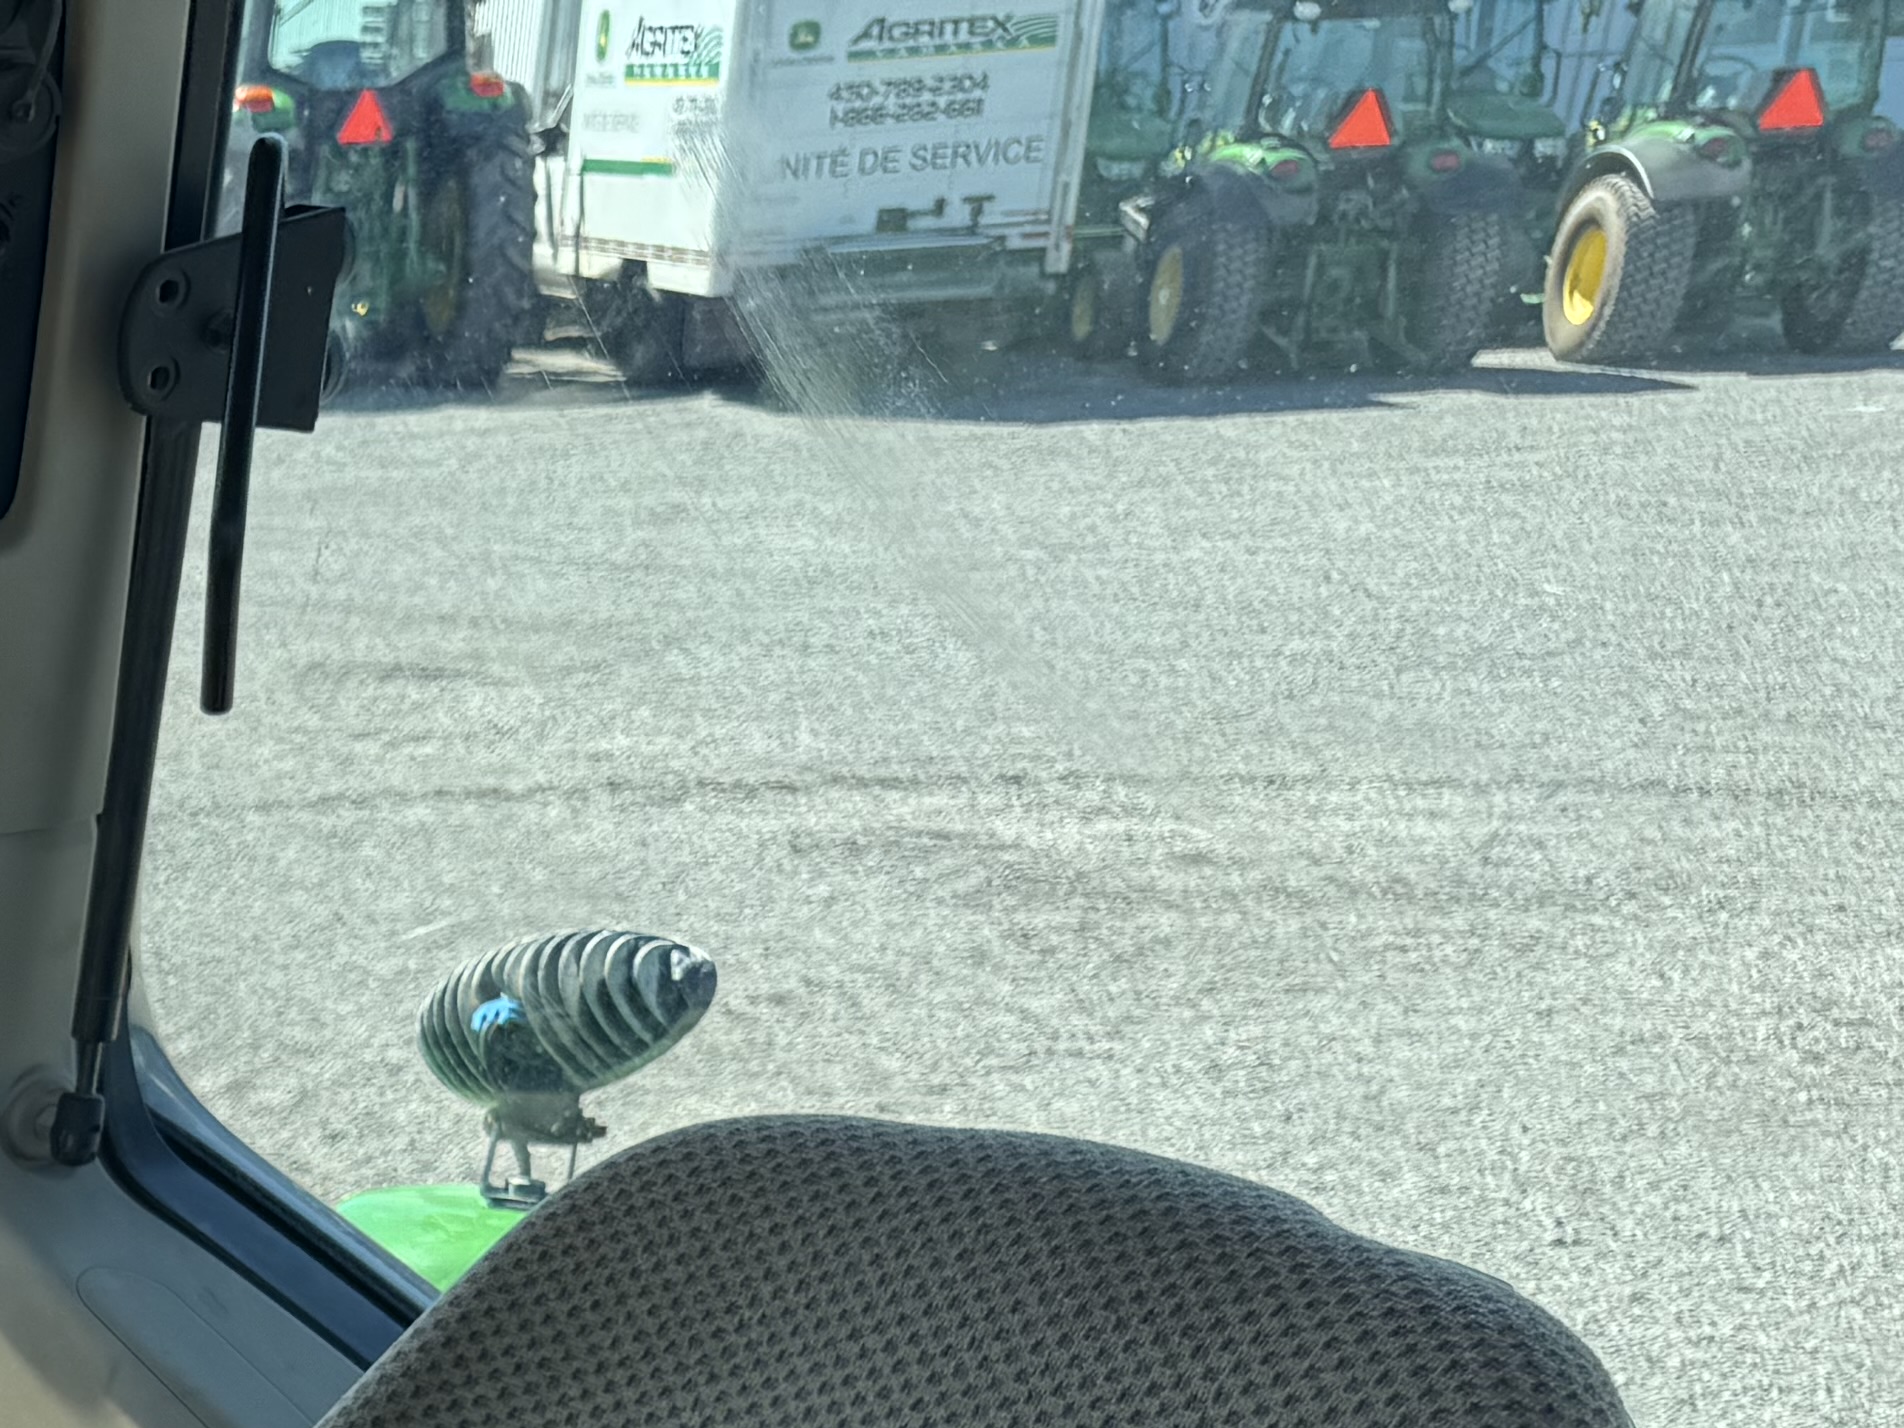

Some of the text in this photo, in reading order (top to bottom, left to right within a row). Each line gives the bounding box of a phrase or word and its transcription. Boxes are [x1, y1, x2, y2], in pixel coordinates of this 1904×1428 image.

[848, 11, 1014, 46] AGRITEX
[778, 135, 1045, 182] NITÉ DE SERVICE
